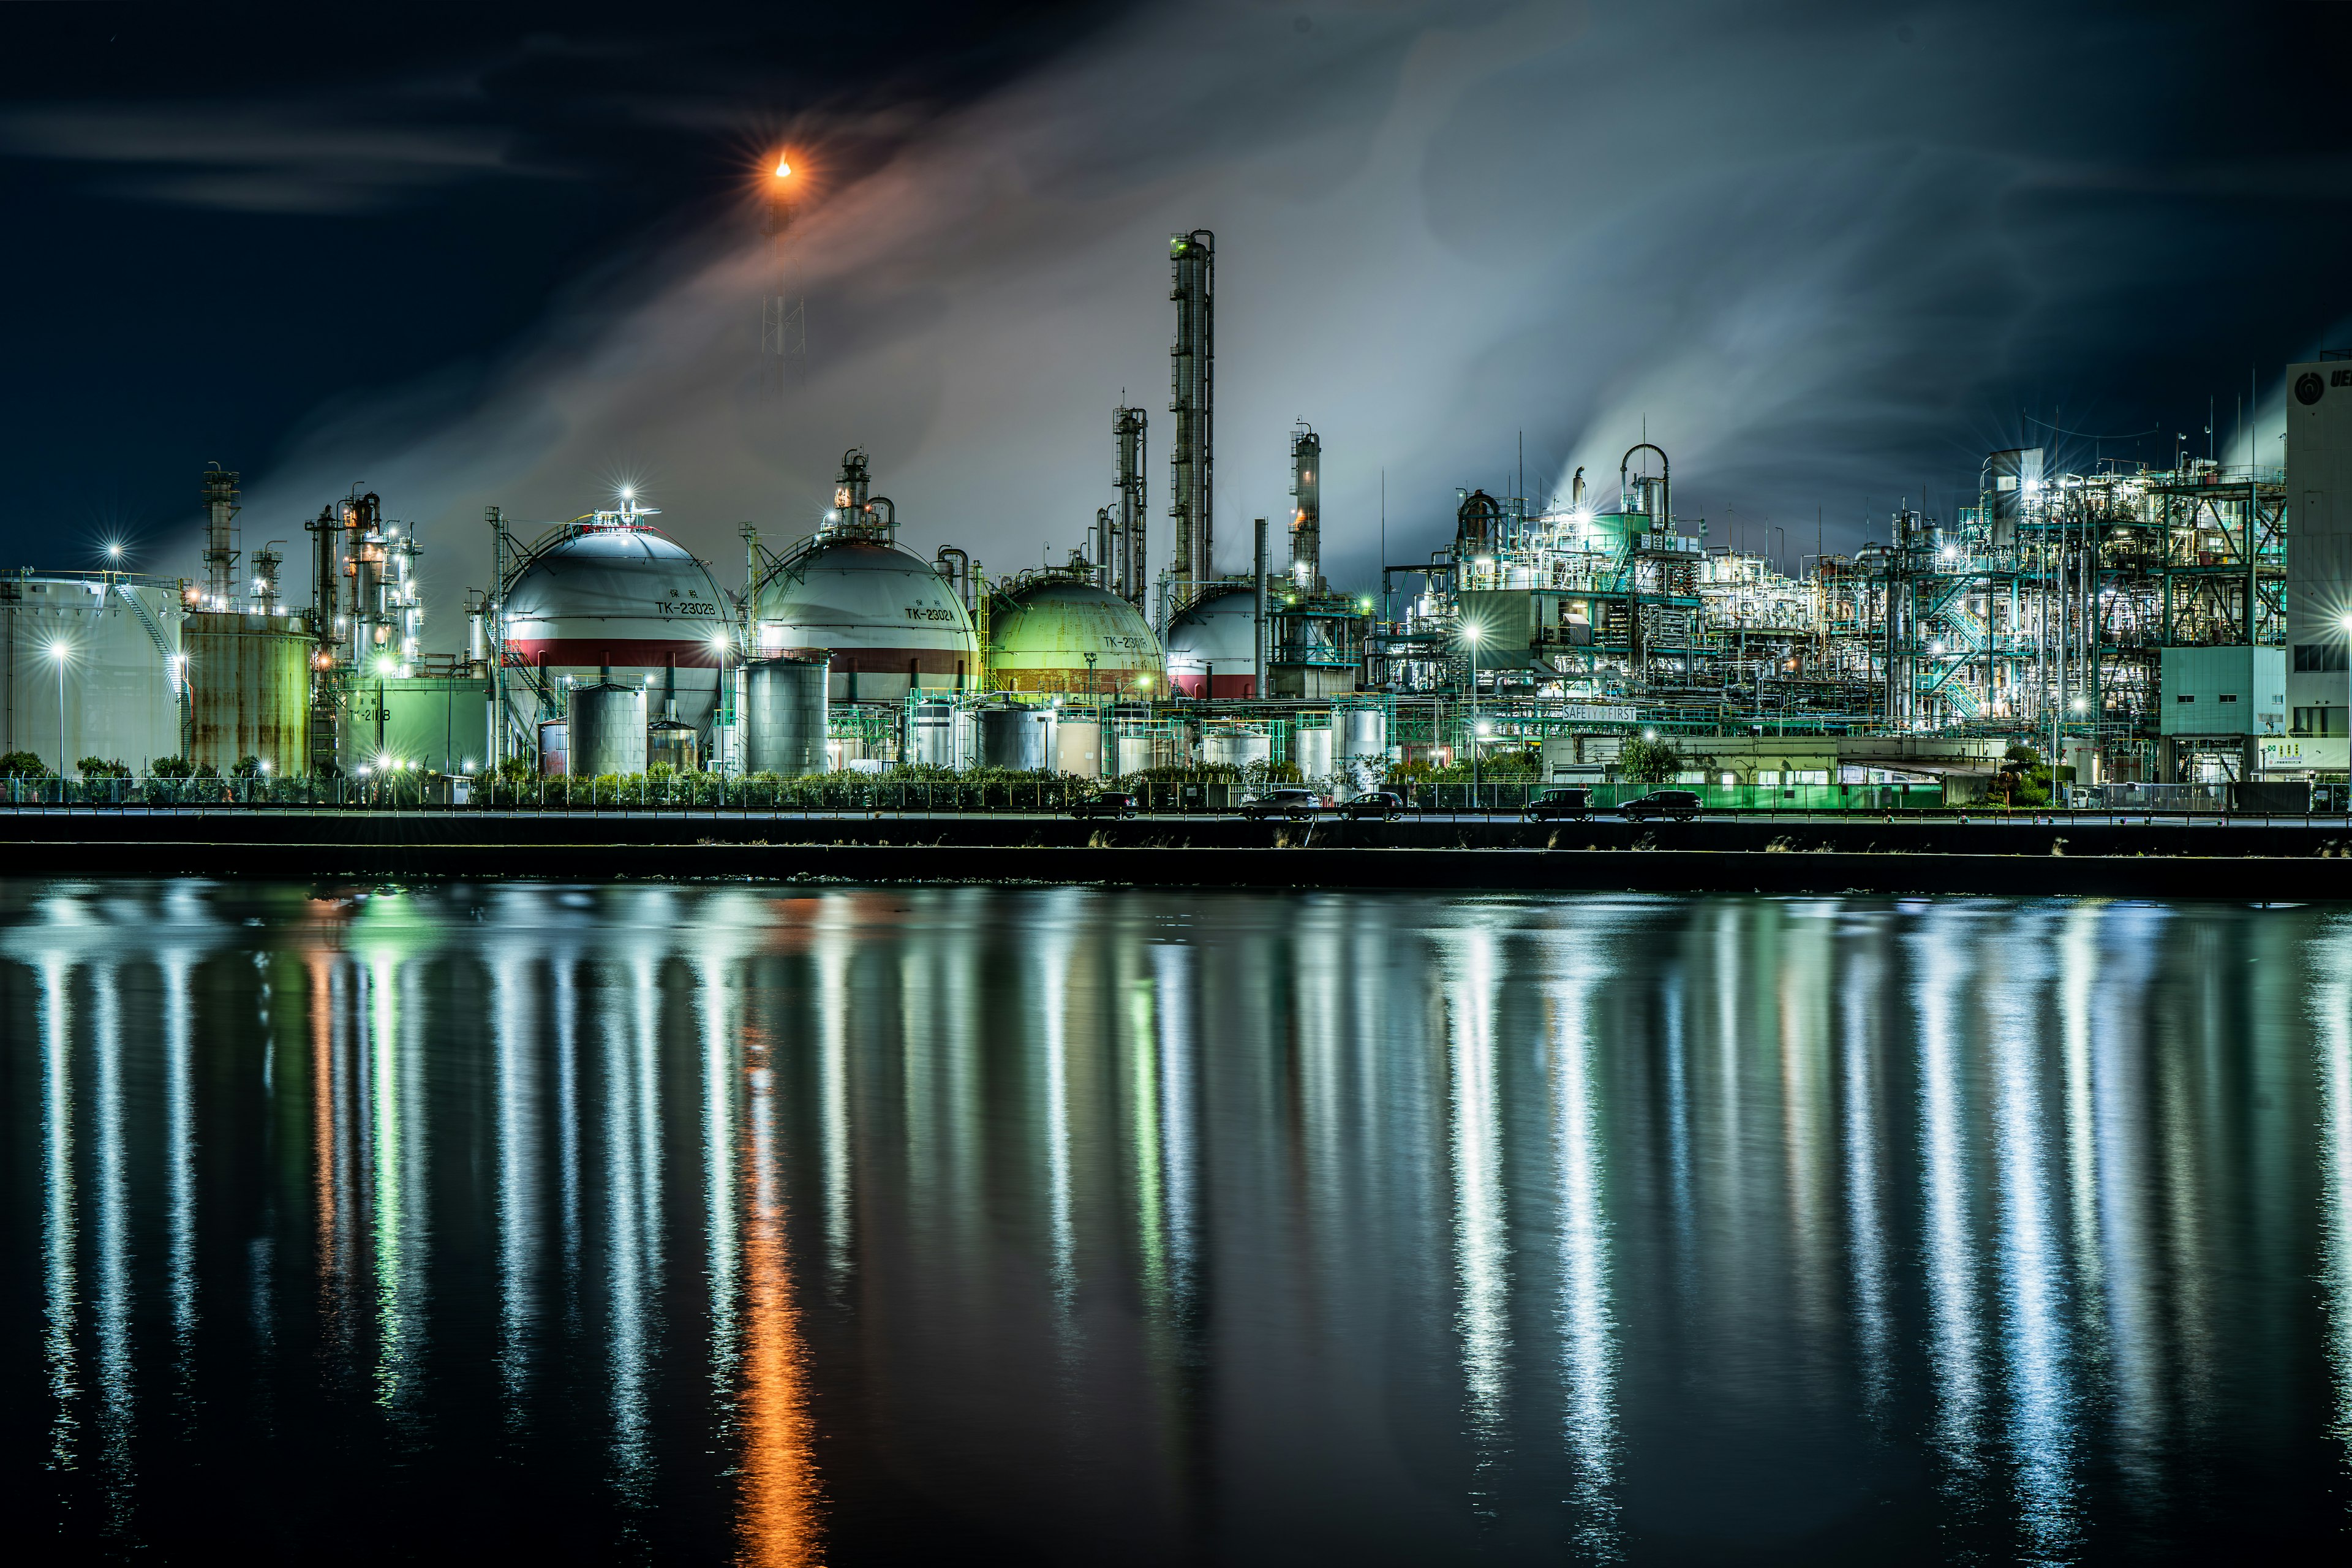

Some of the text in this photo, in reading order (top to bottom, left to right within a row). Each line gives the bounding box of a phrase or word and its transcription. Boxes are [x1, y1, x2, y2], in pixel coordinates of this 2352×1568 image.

[2331, 370, 2352, 387] UE
[1642, 536, 1662, 549] 安全
[670, 589, 698, 598] 保税
[655, 602, 715, 615] TK-2302B
[905, 608, 956, 622] TK-2302A
[1564, 706, 1635, 720] SAFETY FIRST
